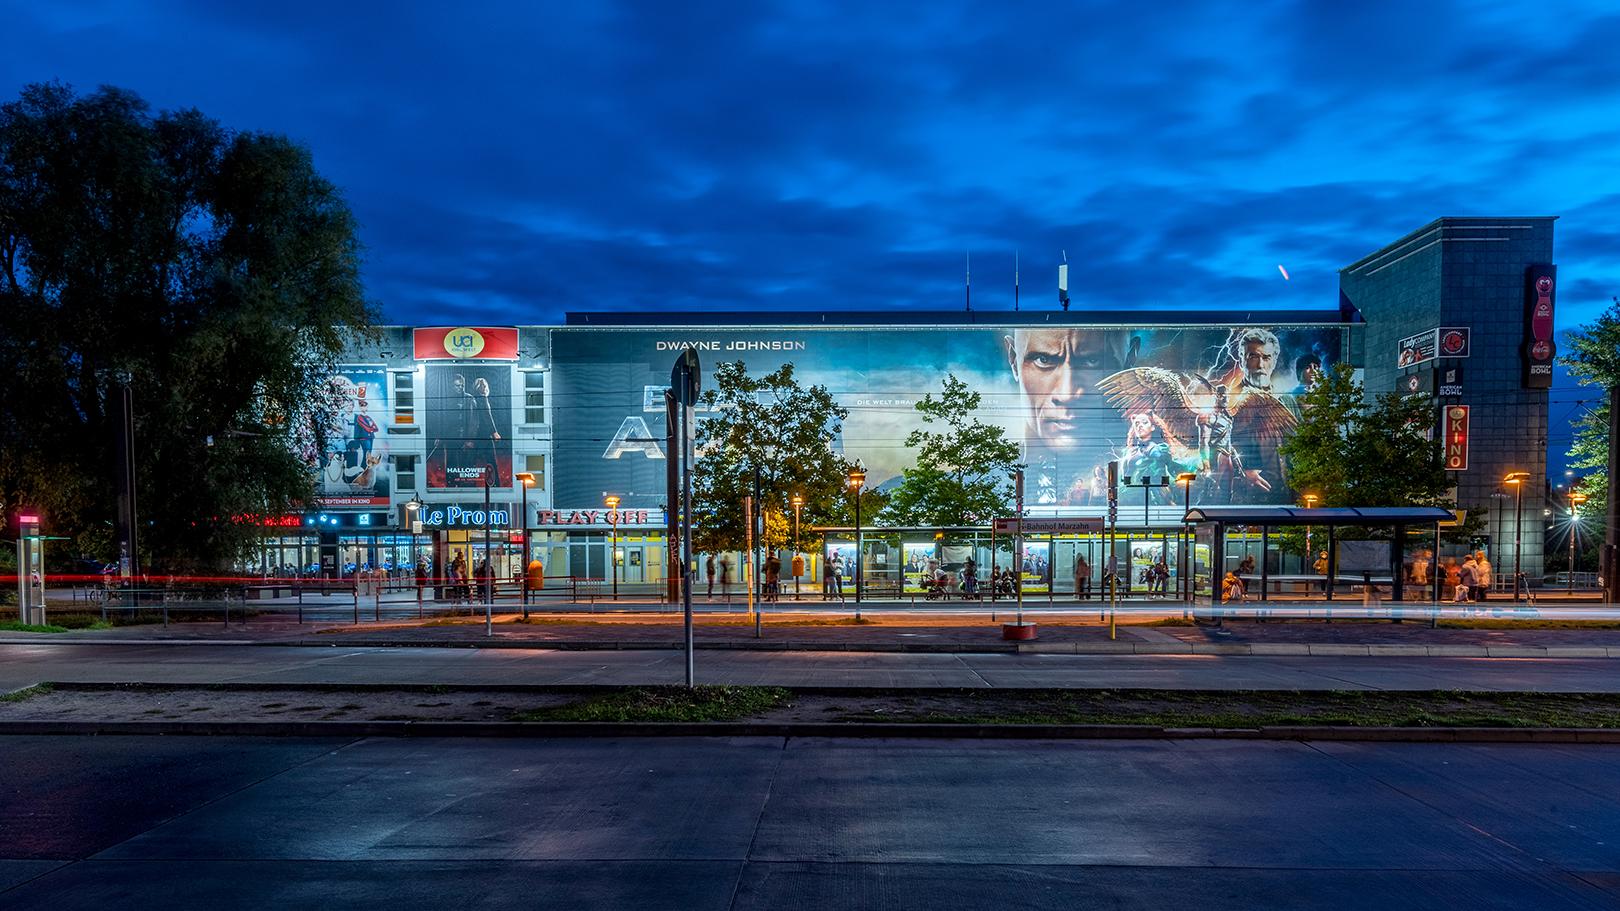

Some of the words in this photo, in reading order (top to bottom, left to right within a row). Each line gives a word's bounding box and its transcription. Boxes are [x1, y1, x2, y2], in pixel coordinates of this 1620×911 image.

[656, 341, 720, 350] DWAYNE
[726, 341, 806, 350] JOHNSON
[1450, 420, 1462, 467] KINO
[447, 506, 509, 525] Prom
[537, 510, 599, 525] PLAY
[606, 510, 648, 525] OFF
